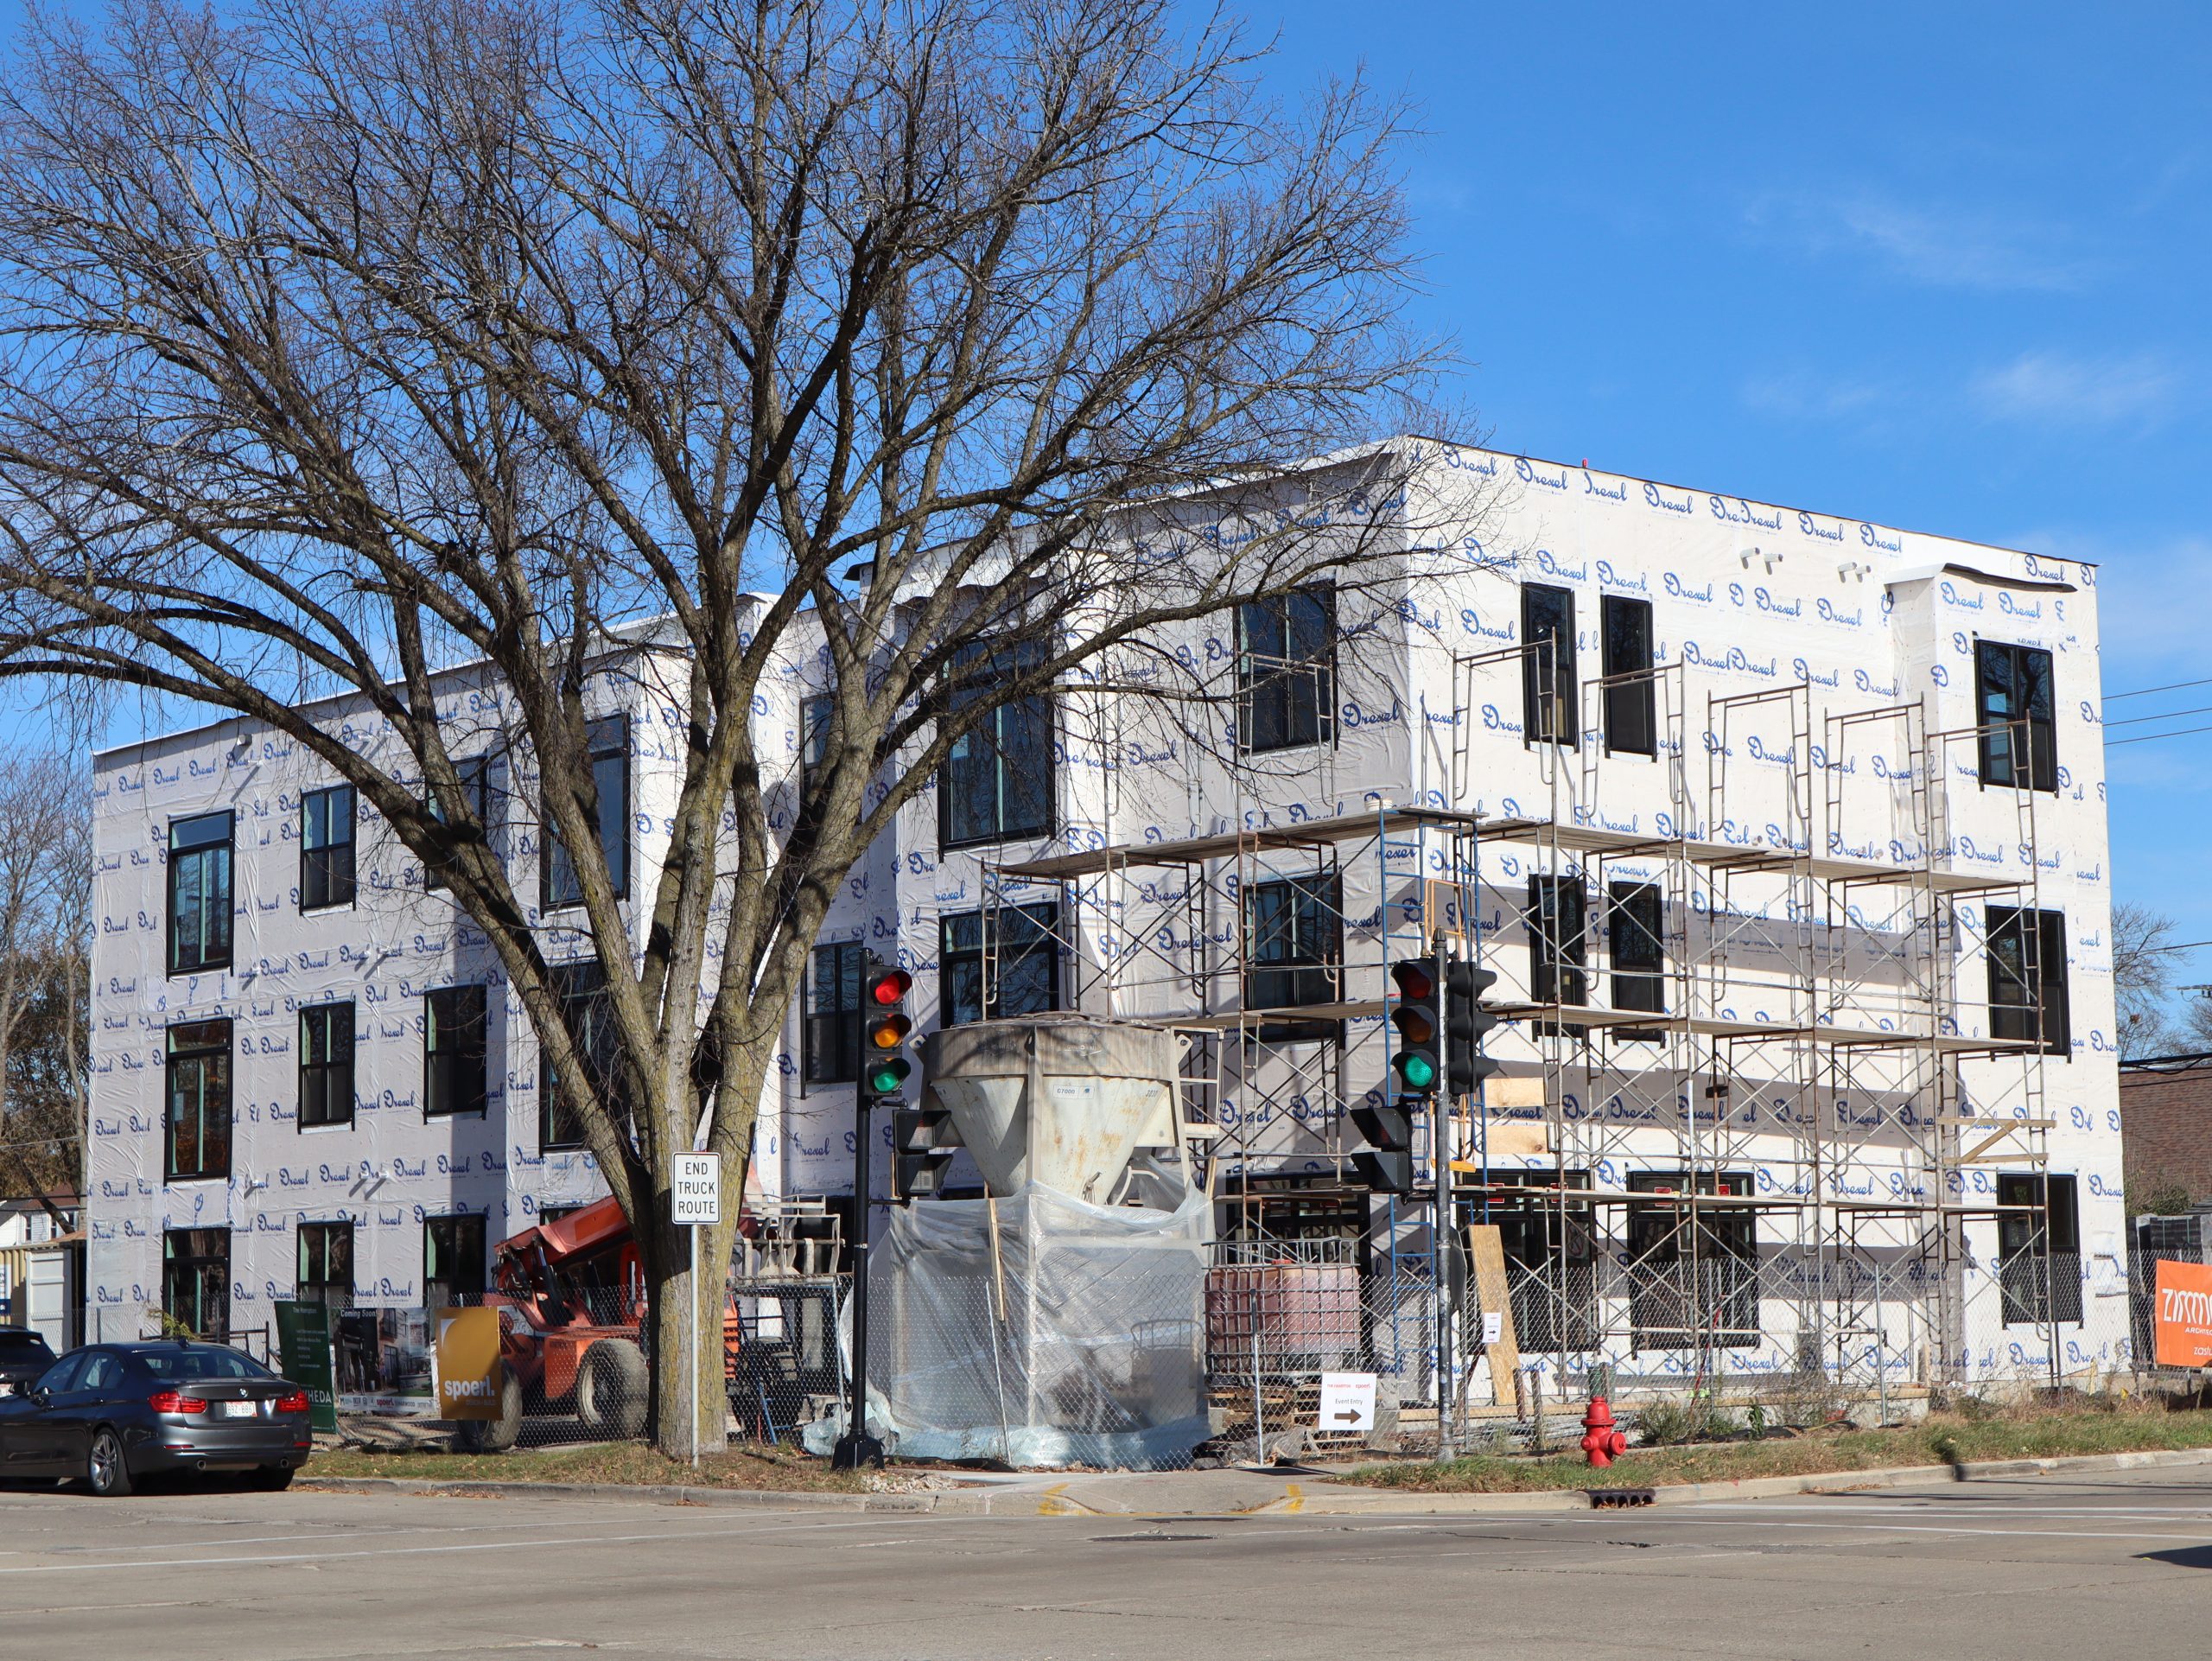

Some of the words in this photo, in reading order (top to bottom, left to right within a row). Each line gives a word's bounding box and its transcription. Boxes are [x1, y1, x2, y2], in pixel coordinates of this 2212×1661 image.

[1442, 443, 1501, 476] Drexel
[1515, 460, 1571, 490] Drexel
[1645, 484, 1693, 512] Drexel
[1799, 512, 1844, 540] Drexel
[1861, 525, 1902, 552] Drexel
[1536, 549, 1587, 581] Drexel
[2024, 554, 2066, 582] Drexel
[1663, 571, 1713, 602] Drexel
[1940, 581, 1983, 609] Drexel
[1755, 586, 1802, 617] Drexel
[1815, 596, 1863, 626] Drexel
[1999, 591, 2042, 618] Drexel
[1462, 608, 1516, 640] Drexel
[1684, 640, 1734, 670] Drexel
[1727, 646, 1777, 677] Drexel
[1853, 668, 1902, 697] Drexel
[1342, 703, 1398, 728] Drexel
[1747, 735, 1795, 766] Drexel
[154, 767, 181, 786] Drexel
[190, 760, 217, 778] Drexel
[119, 774, 144, 794] Drexel
[1961, 835, 2005, 862] Drexel
[105, 916, 128, 933] Drexel
[415, 933, 445, 953] Drexel
[298, 950, 330, 968] Drexel
[111, 977, 136, 992] Drexel
[262, 1036, 290, 1053] Drexel
[384, 1088, 415, 1106] Drexel
[1290, 1093, 1346, 1121] Drexel
[270, 1100, 297, 1119] Drexel
[96, 1120, 120, 1135] Drexel
[320, 1163, 350, 1183] Drexel
[394, 1157, 426, 1176] Drexel
[438, 1154, 471, 1174] Drexel
[685, 1162, 709, 1175] END
[280, 1166, 309, 1186] Drexel
[104, 1179, 129, 1197] Drexel
[677, 1181, 715, 1194] TRUCK
[678, 1200, 715, 1214] ROUTE
[259, 1212, 287, 1231] Drexel
[99, 1286, 123, 1303] Drexel
[267, 1280, 294, 1303] Drexel
[382, 1277, 412, 1296] Drexel
[340, 1310, 360, 1319] Coming
[444, 1376, 495, 1401] spoerl.
